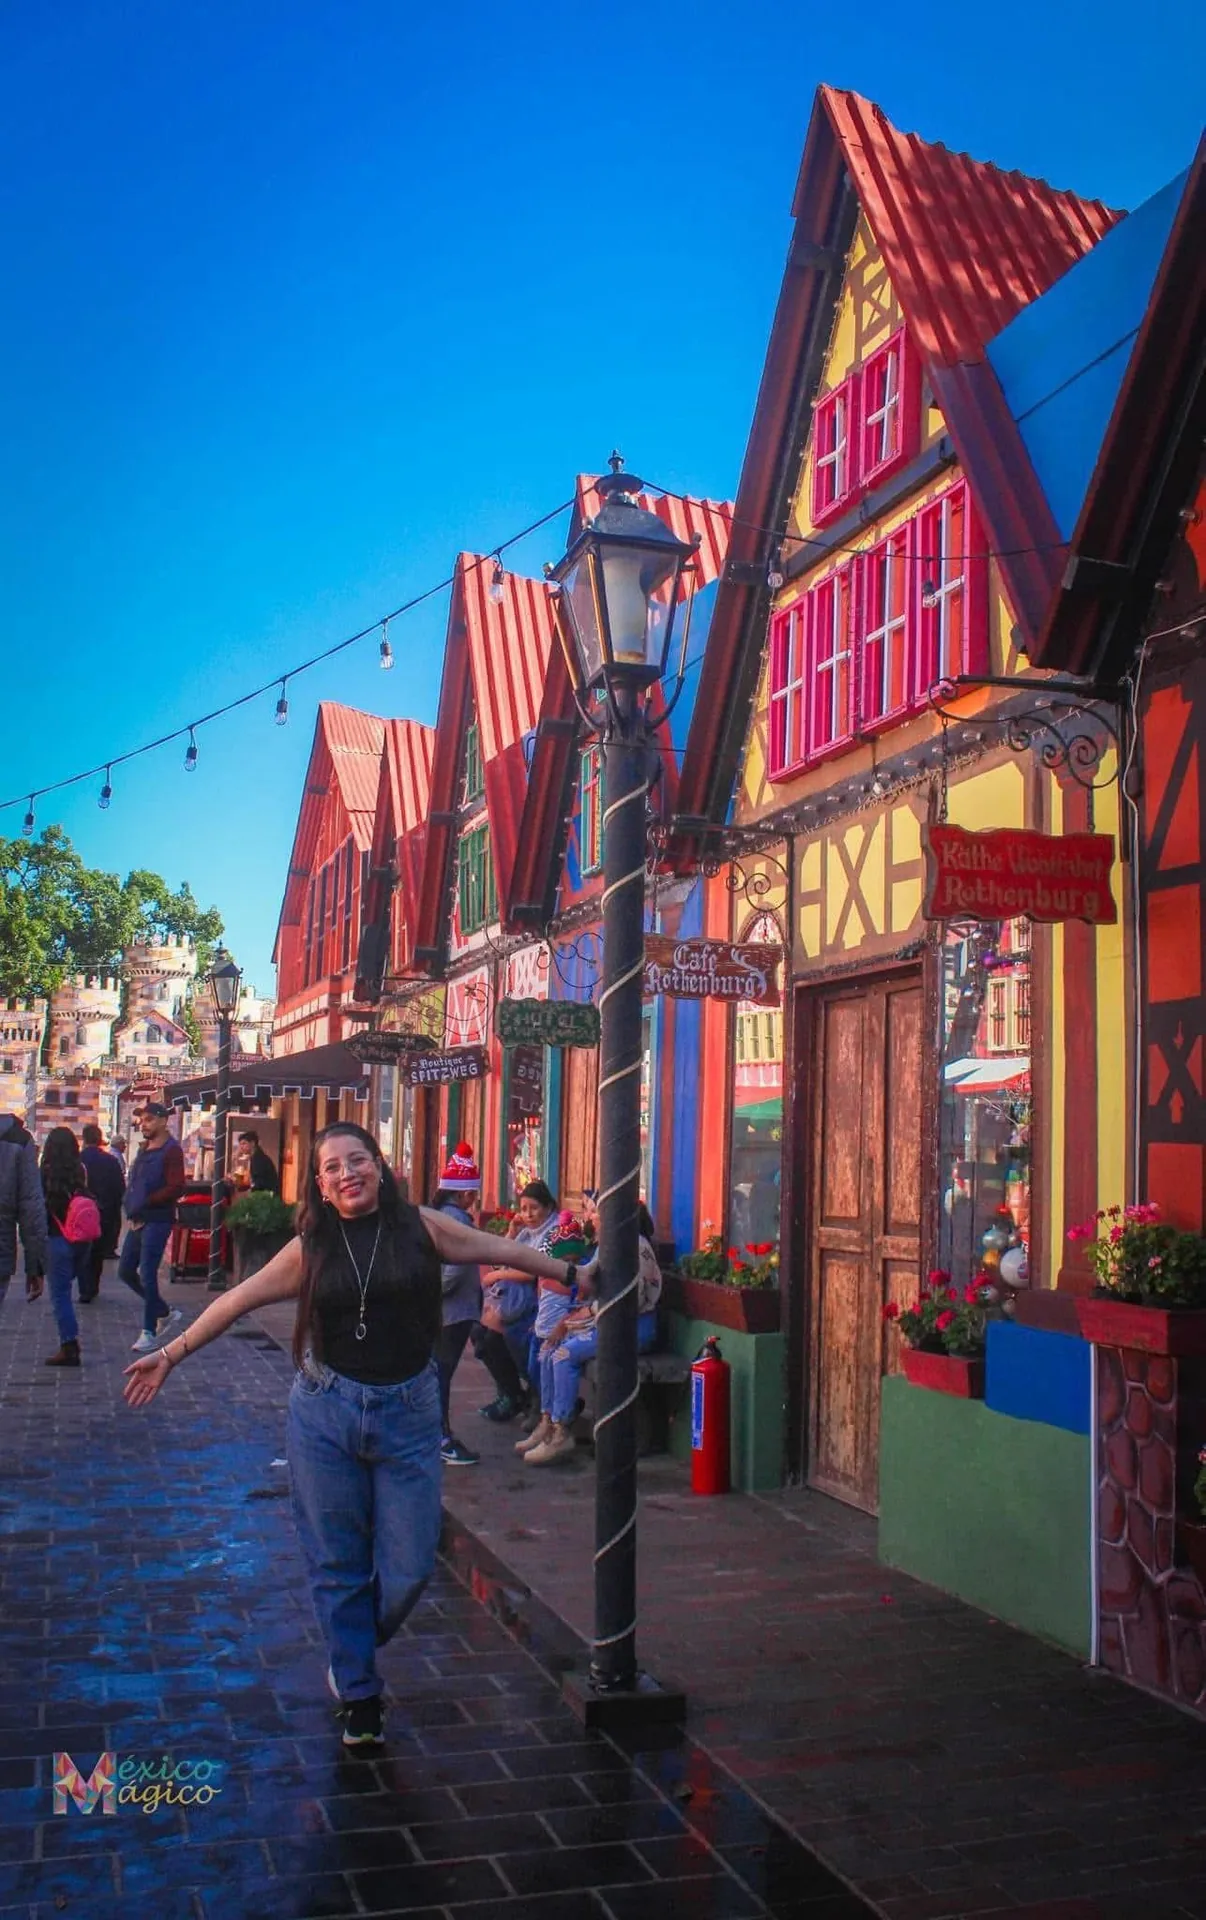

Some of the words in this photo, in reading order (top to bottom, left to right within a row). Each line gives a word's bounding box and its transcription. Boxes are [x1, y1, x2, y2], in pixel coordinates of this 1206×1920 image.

[942, 875, 1099, 918] Rothenburg
[644, 961, 760, 999] Rothenburg
[411, 1063, 478, 1083] SPITZWEG
[419, 1056, 463, 1069] Boutique
